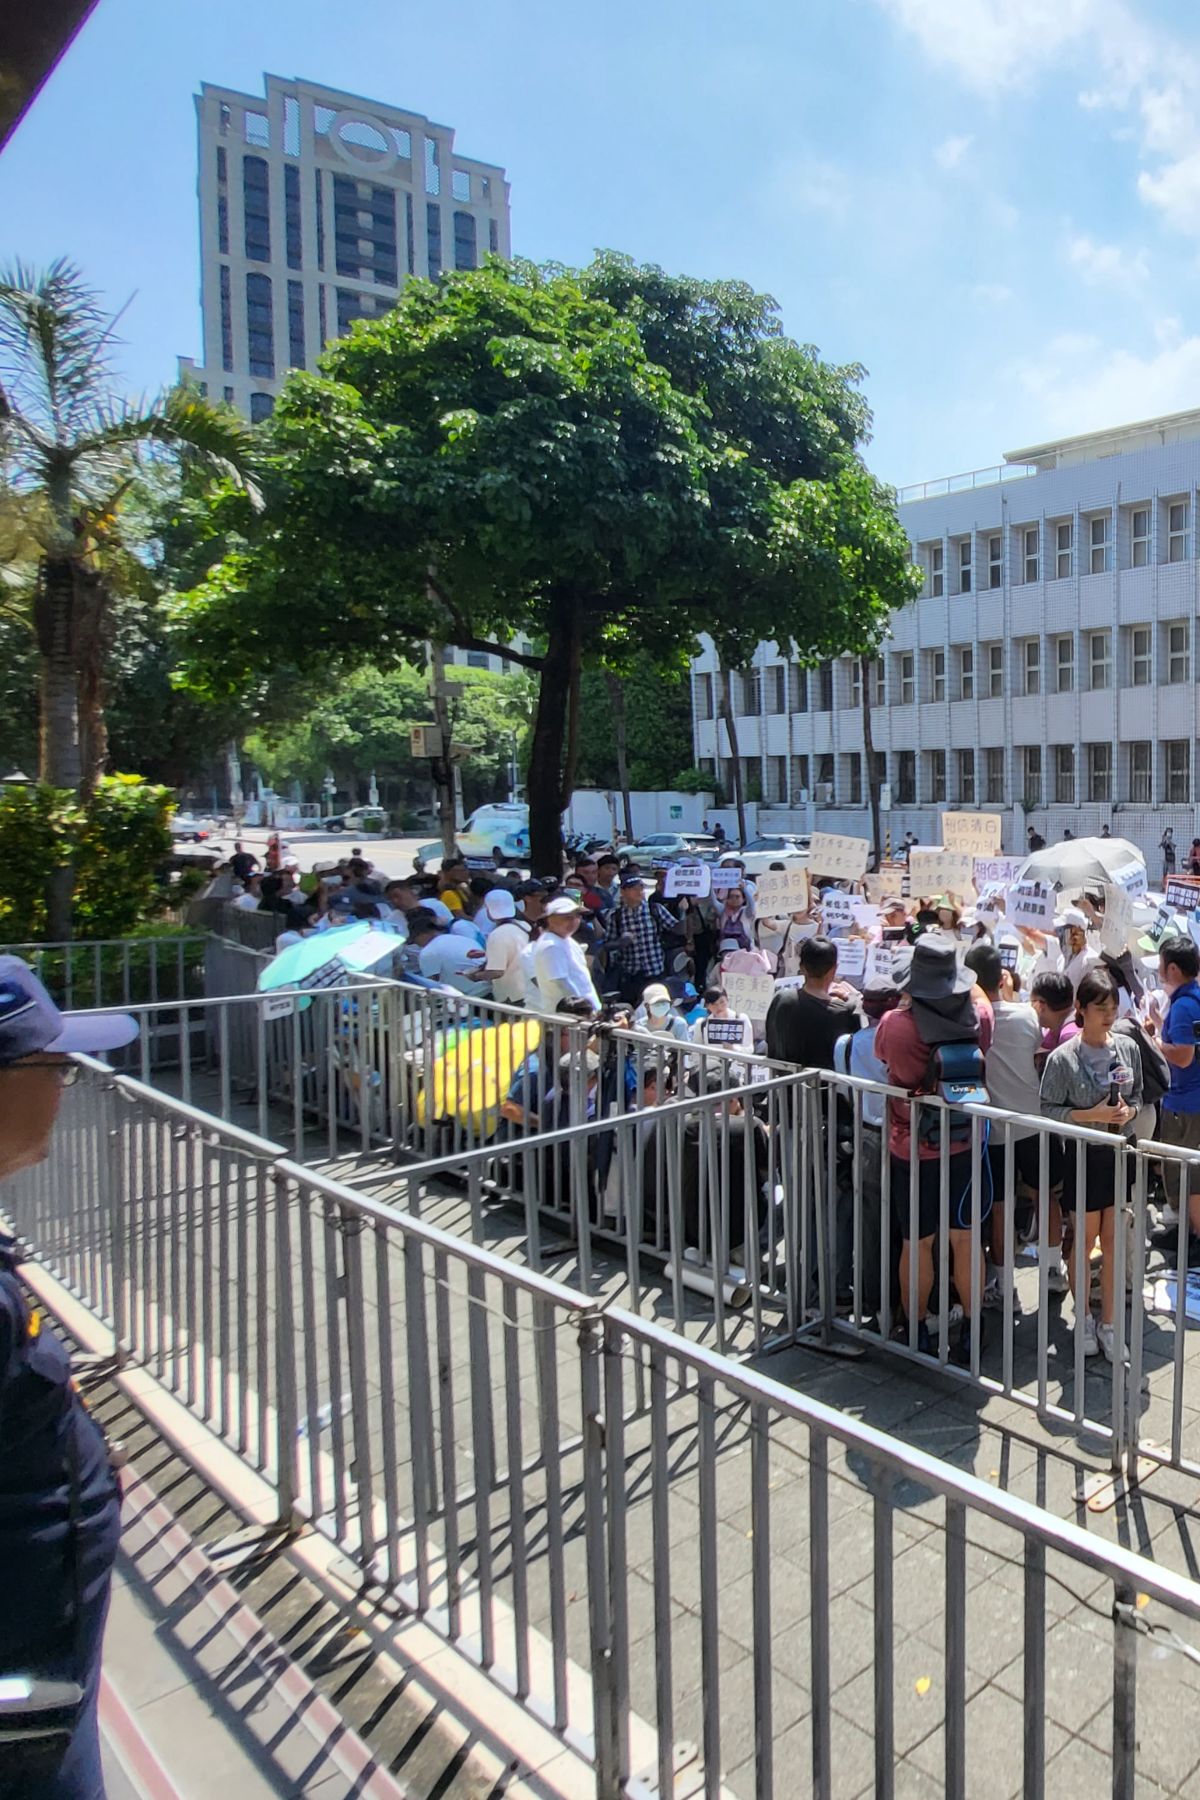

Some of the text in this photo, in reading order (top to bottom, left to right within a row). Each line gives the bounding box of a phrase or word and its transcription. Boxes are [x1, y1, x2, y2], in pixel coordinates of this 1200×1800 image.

[945, 817, 997, 833] 相信清白
[826, 900, 859, 909] 相信清
